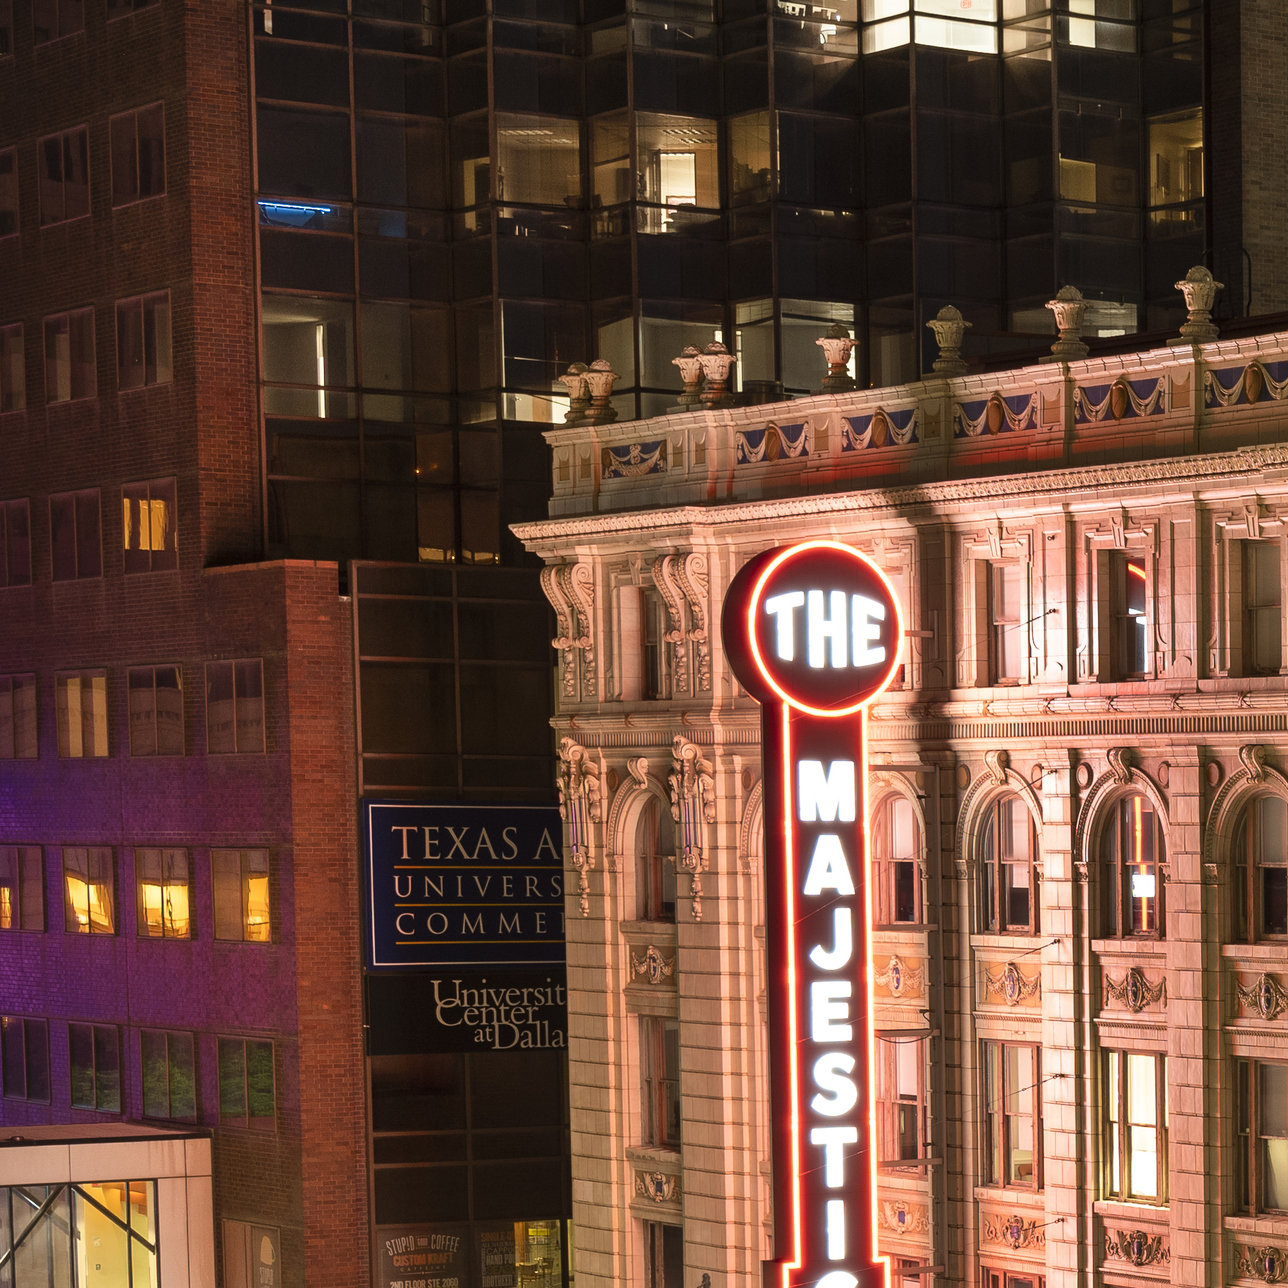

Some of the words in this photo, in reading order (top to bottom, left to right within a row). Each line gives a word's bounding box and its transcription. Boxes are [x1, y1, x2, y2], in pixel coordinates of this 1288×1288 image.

[765, 589, 886, 668] THE
[391, 826, 518, 861] TEXAS
[393, 875, 562, 898] UNIVERS
[395, 912, 565, 936] COMME
[430, 978, 566, 1008] Universit
[435, 998, 539, 1027] Center
[474, 1027, 492, 1043] at
[491, 1020, 567, 1050] Dalla
[431, 1234, 460, 1253] COFFEE
[427, 1278, 441, 1288] STE
